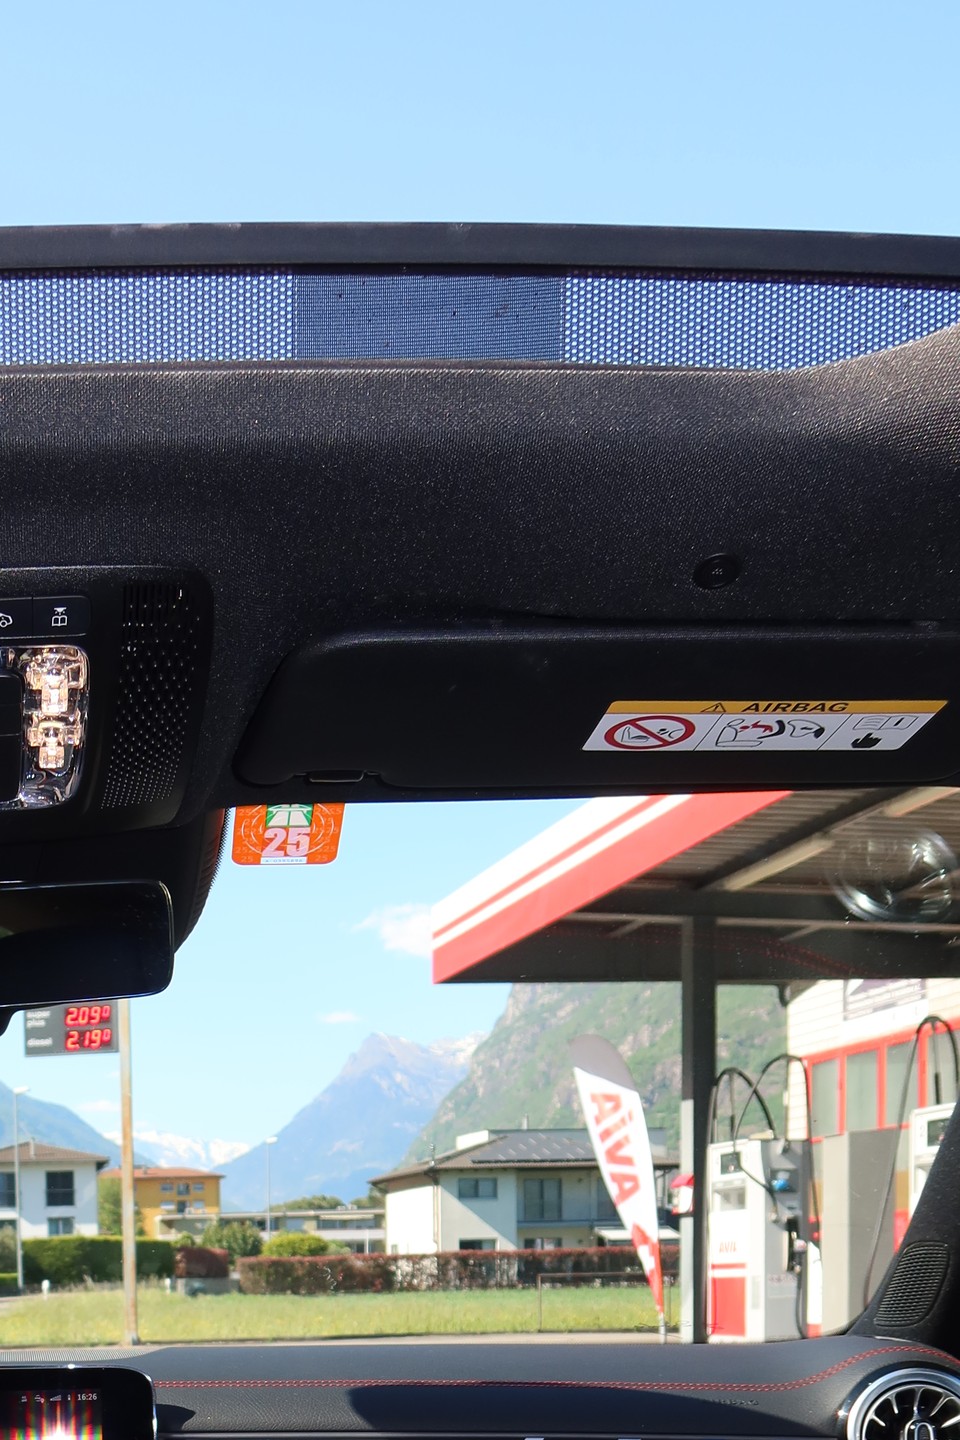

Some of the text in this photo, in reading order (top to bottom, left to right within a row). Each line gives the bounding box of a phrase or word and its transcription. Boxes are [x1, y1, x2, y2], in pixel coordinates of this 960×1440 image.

[741, 702, 850, 713] AIRBAG
[262, 827, 311, 857] 25
[77, 1393, 98, 1401] 16:26
